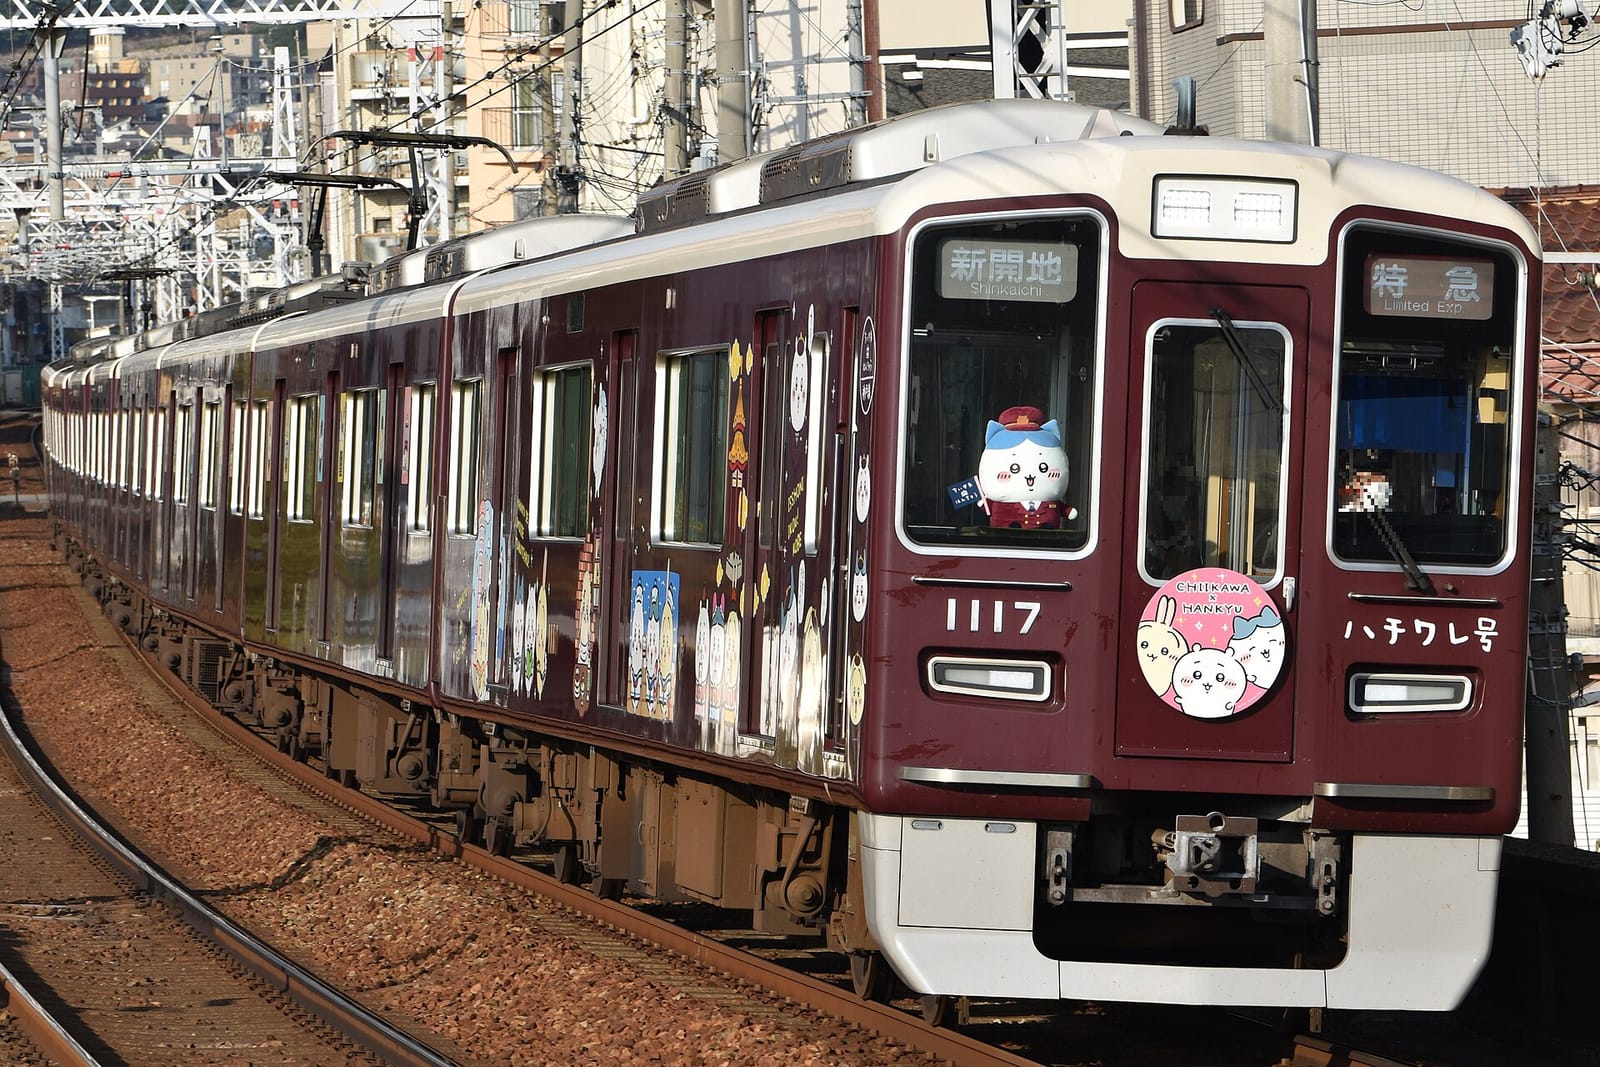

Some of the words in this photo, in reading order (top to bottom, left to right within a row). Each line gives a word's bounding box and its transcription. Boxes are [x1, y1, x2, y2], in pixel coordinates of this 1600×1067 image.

[950, 247, 1062, 285] 新開地
[970, 282, 1042, 297] Shinkaichi
[1372, 263, 1480, 302] 特急
[1384, 300, 1429, 313] Limited
[1437, 301, 1465, 315] Exp.
[1175, 582, 1251, 594] CHIIKAWA
[946, 598, 1041, 634] 1117
[1183, 603, 1244, 615] HANKYU
[1343, 616, 1500, 653] ハチワレ号
